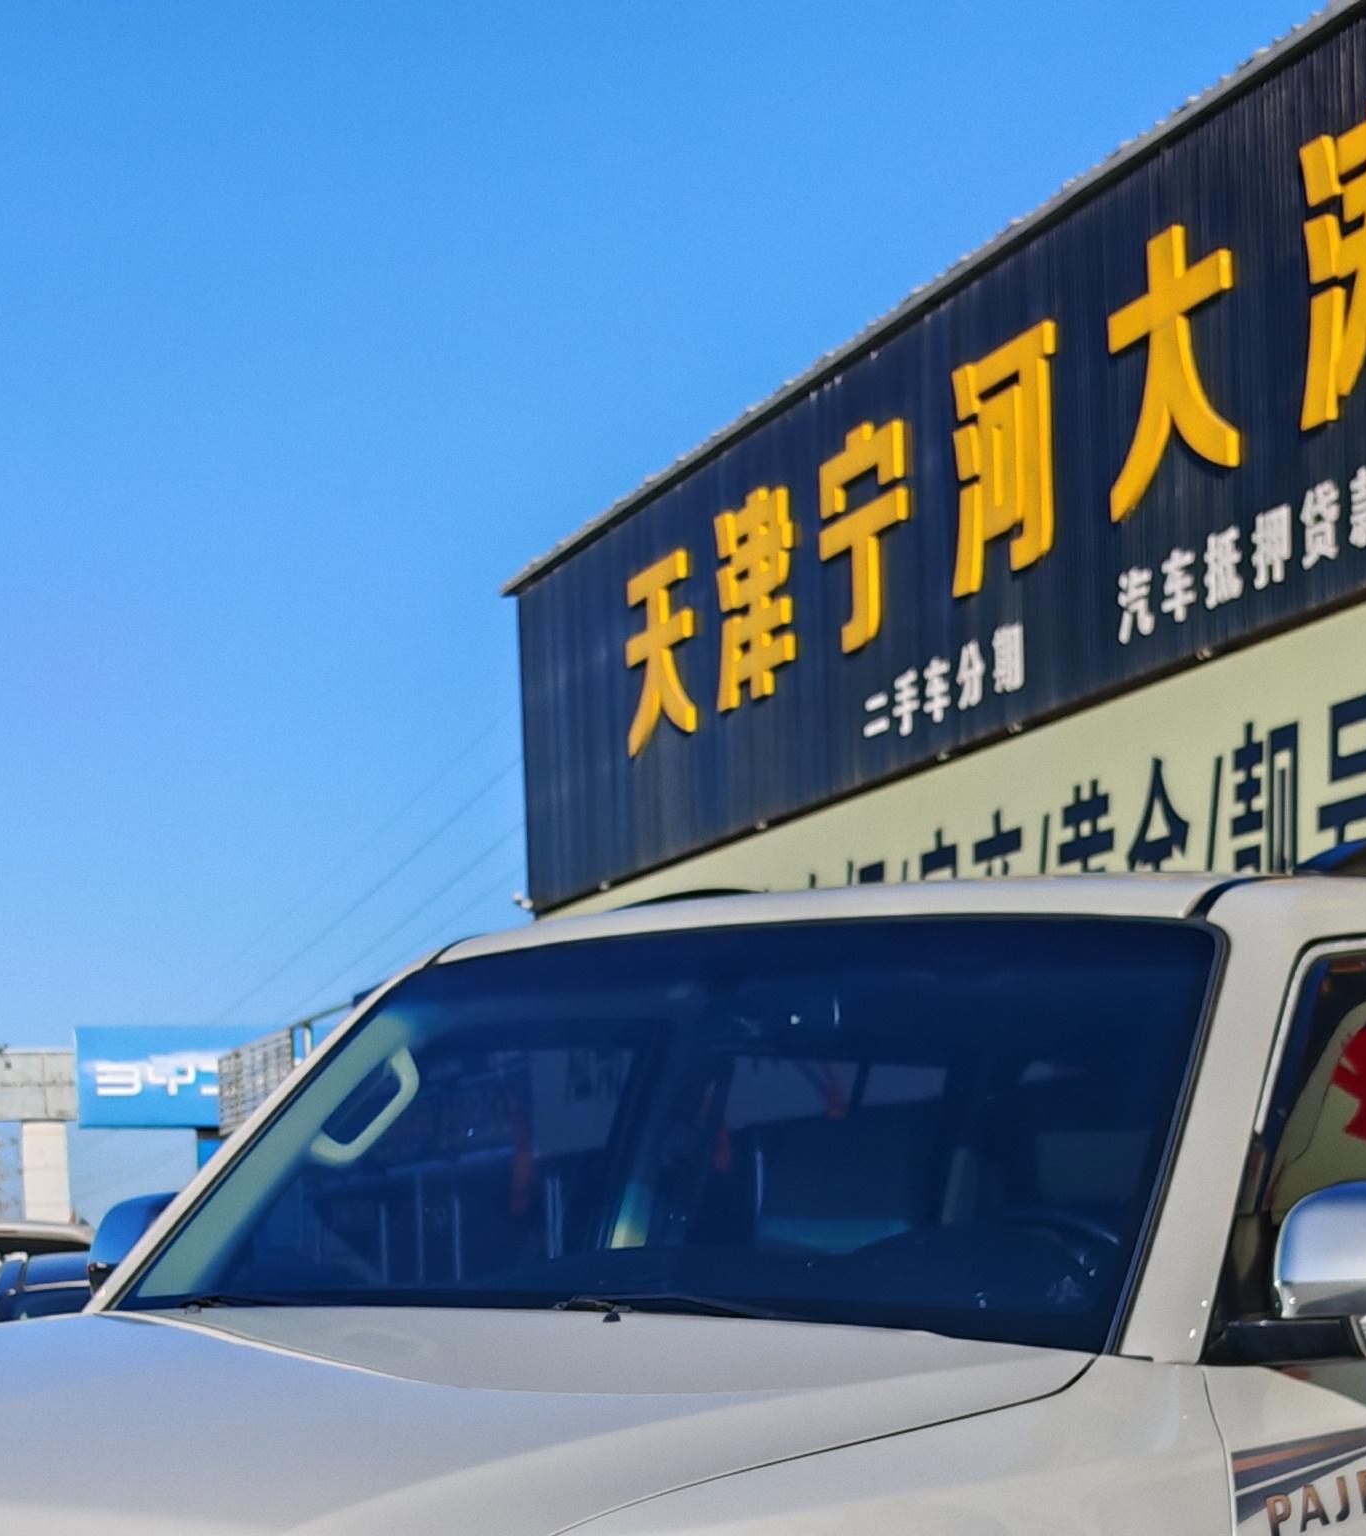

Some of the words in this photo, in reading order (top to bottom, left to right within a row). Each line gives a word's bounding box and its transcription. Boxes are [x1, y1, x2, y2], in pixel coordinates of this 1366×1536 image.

[862, 621, 1026, 739] 二手车分期
